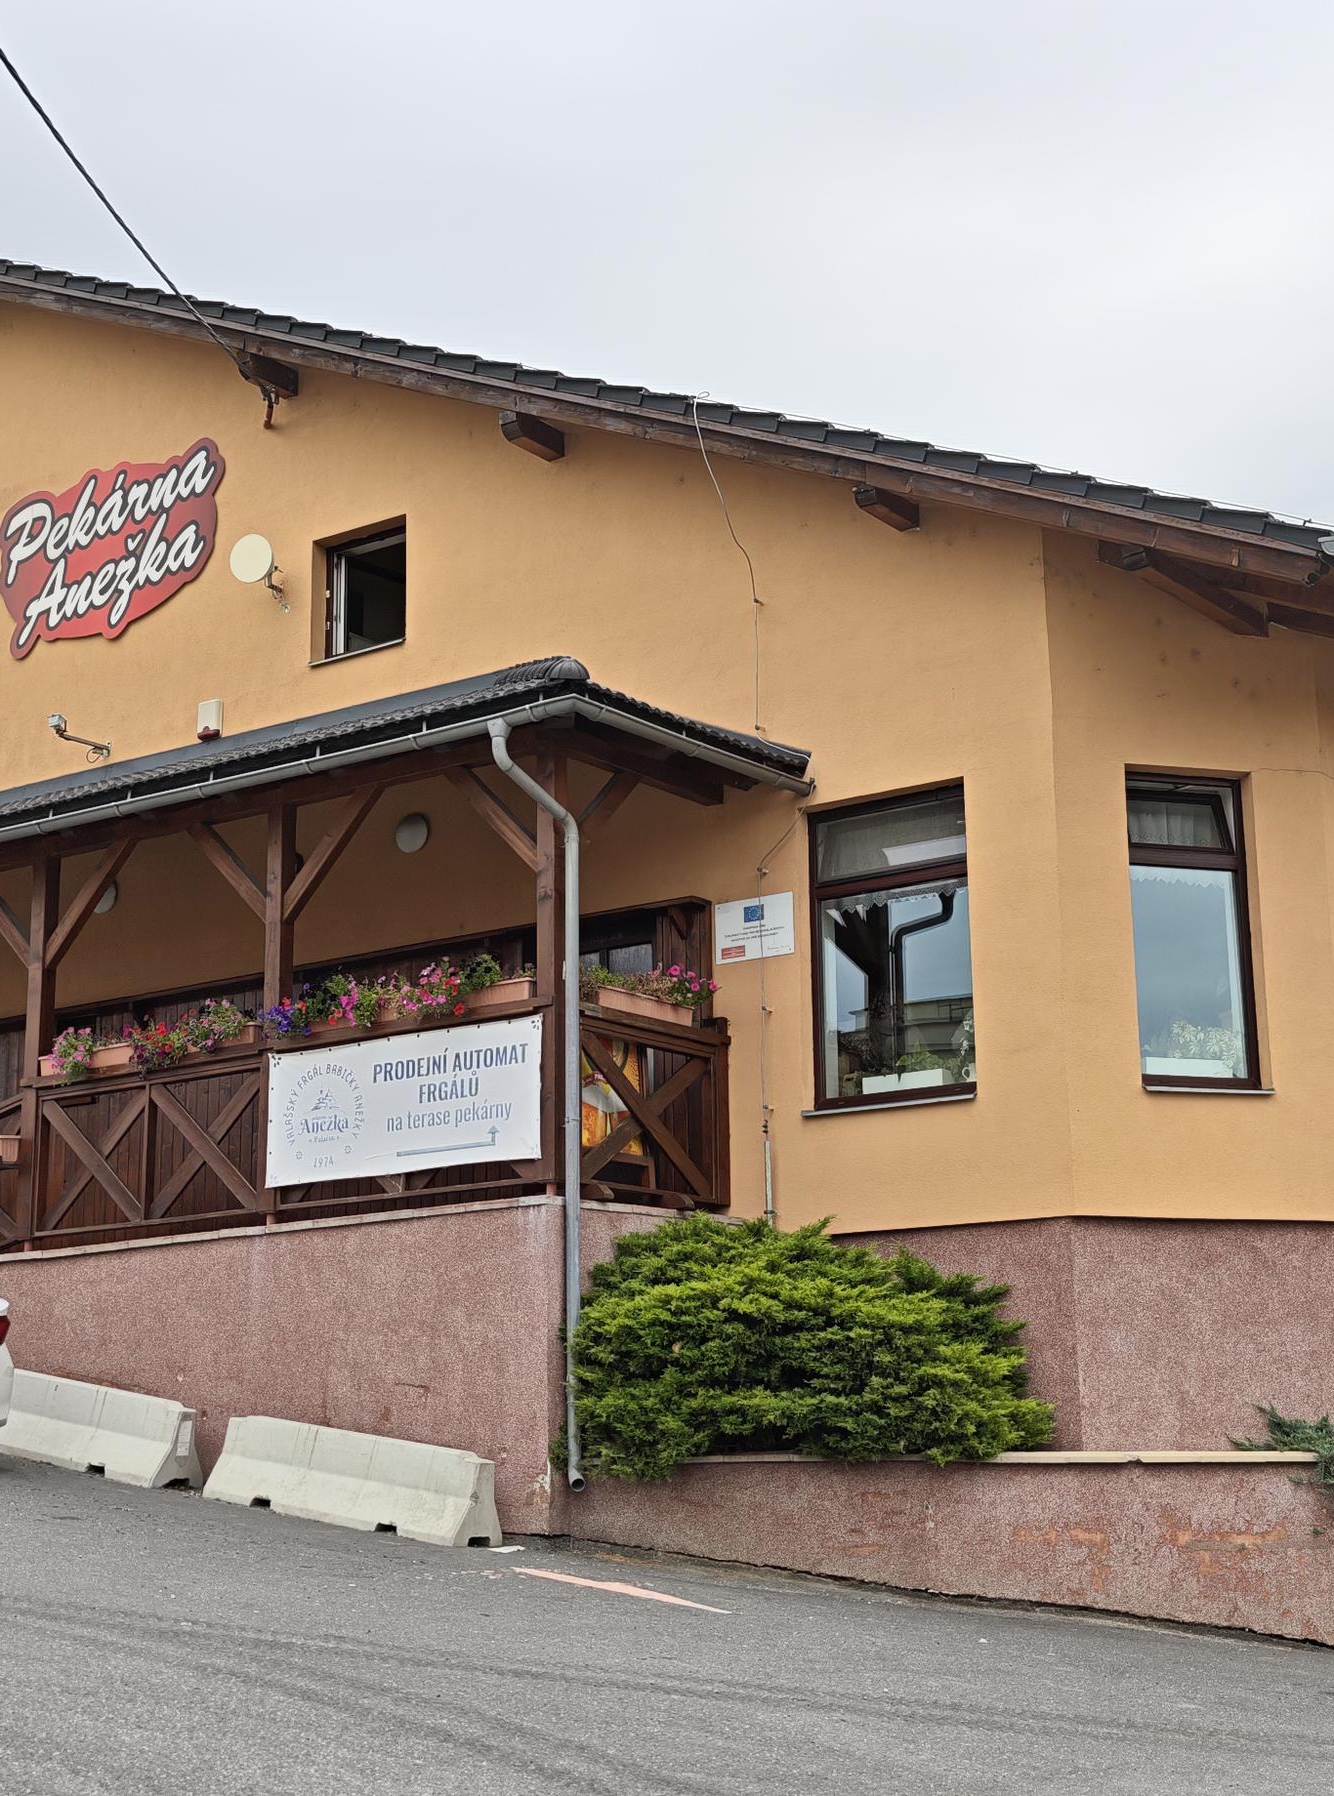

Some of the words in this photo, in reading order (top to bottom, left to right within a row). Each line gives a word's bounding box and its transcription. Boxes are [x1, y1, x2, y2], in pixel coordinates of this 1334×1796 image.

[7, 449, 215, 585] Pekárna
[18, 513, 204, 646] Anežka
[372, 1047, 449, 1084] PRODEJNÍ
[452, 1043, 529, 1073] AUTOMAT
[283, 1088, 299, 1147] VALAŠSKÝ
[297, 1063, 323, 1090] FRGÁL
[325, 1063, 360, 1092] BABIČKY
[351, 1094, 365, 1140] ANEŽKY
[418, 1070, 479, 1104] FRGÁLŮ
[298, 1114, 349, 1136] Anežka
[386, 1115, 403, 1132] na
[407, 1109, 451, 1130] terase
[454, 1099, 513, 1128] pekárny
[313, 1156, 334, 1168] 1974
